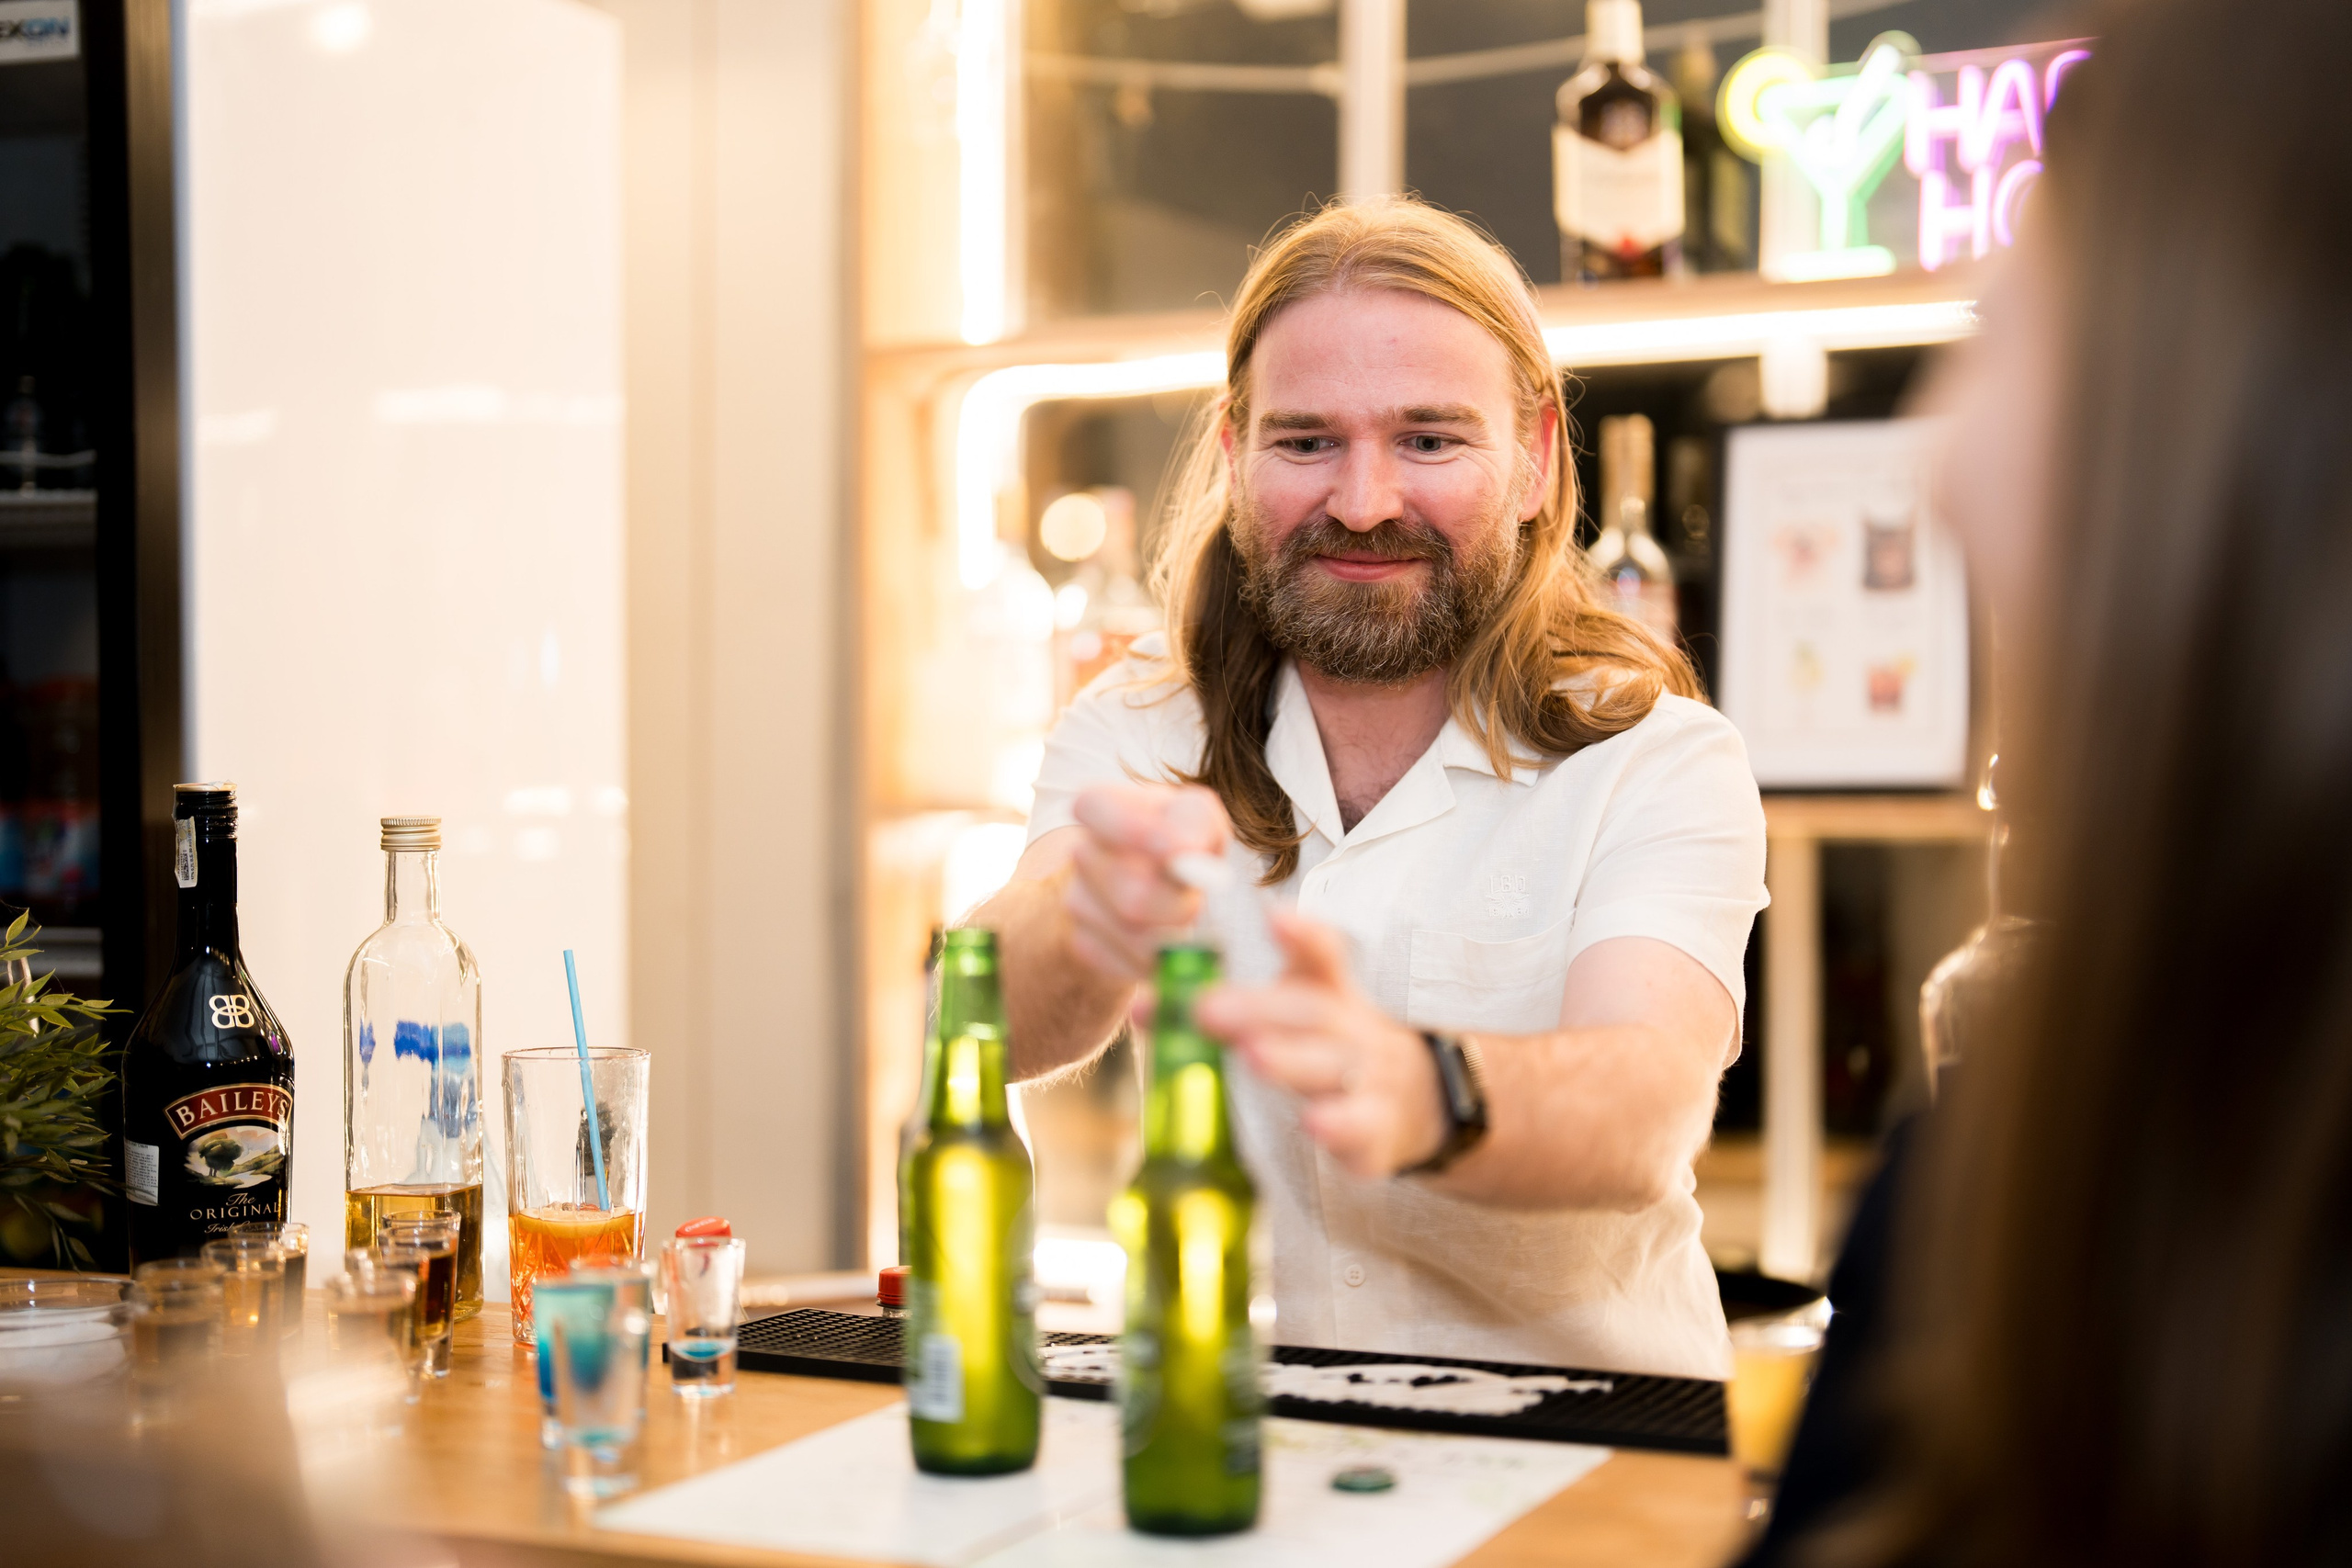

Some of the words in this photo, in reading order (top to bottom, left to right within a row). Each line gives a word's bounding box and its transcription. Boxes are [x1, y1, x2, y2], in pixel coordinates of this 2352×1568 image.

[175, 1090, 288, 1127] BAILEYS
[225, 1192, 256, 1206] The
[189, 1201, 279, 1220] ORIGINAL
